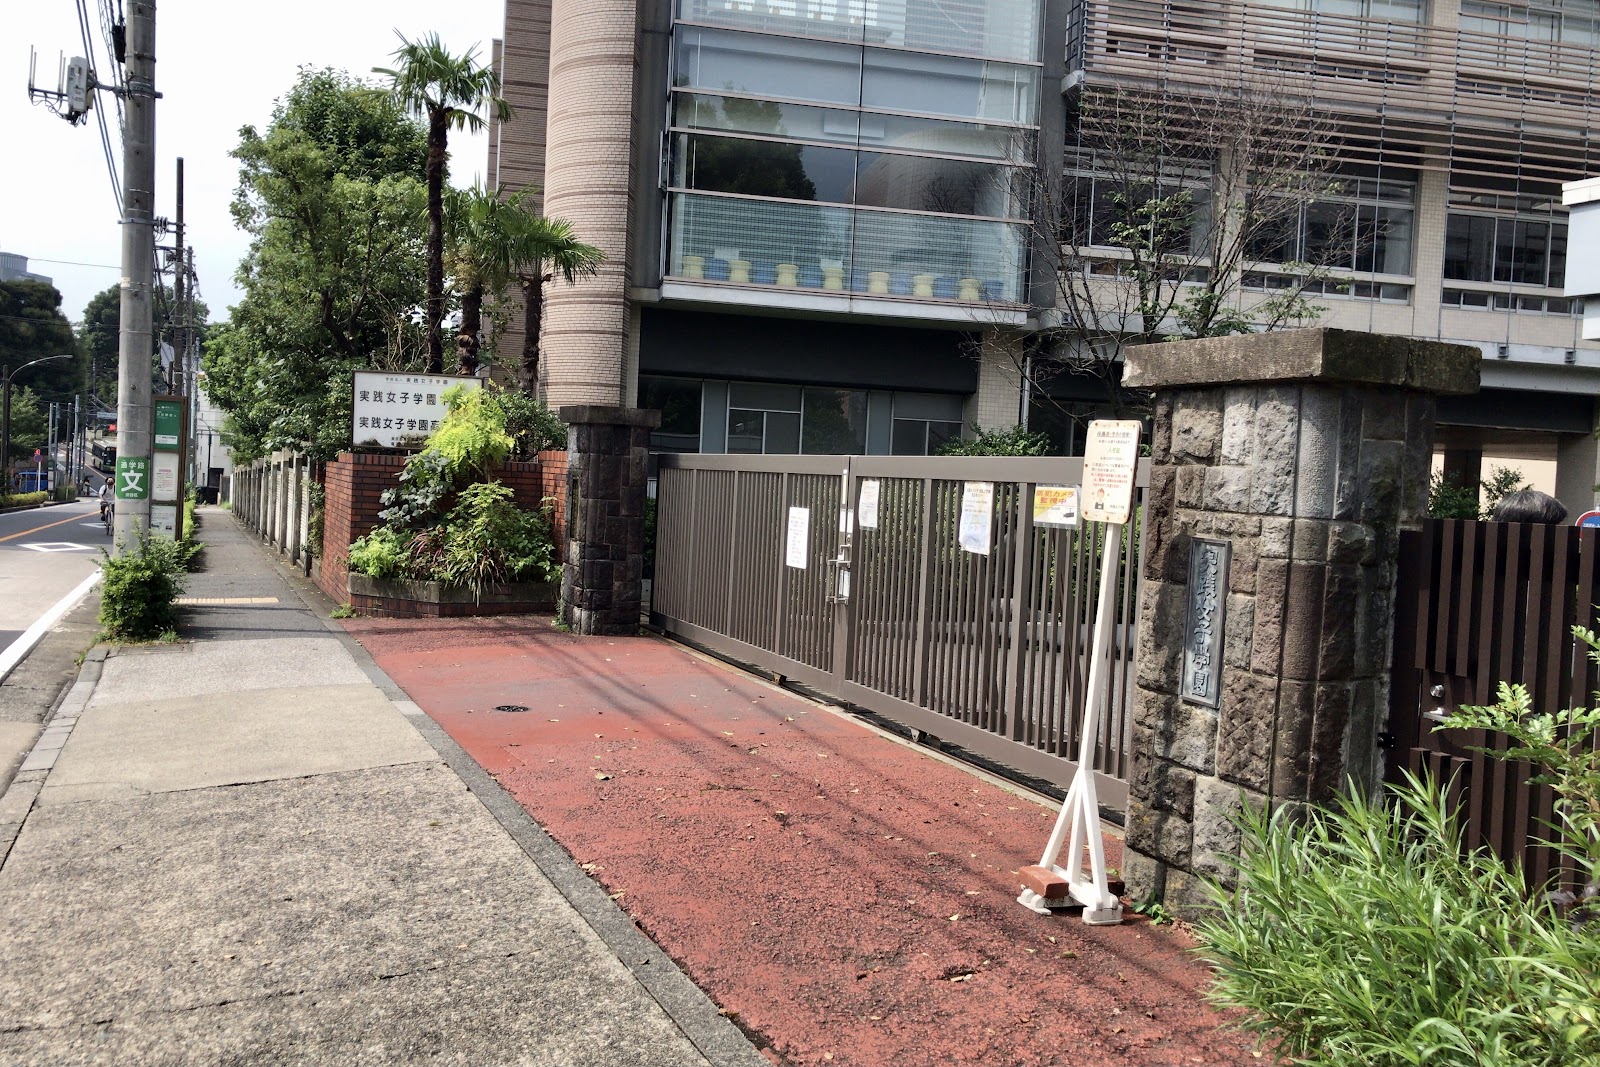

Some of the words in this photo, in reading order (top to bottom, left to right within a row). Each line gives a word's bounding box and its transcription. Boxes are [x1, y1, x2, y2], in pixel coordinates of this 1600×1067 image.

[360, 390, 449, 406] 実践女子学園
[359, 417, 448, 431] 実践女子学園高
[120, 461, 145, 469] 通学路
[1036, 490, 1075, 498] 防犯カメラ
